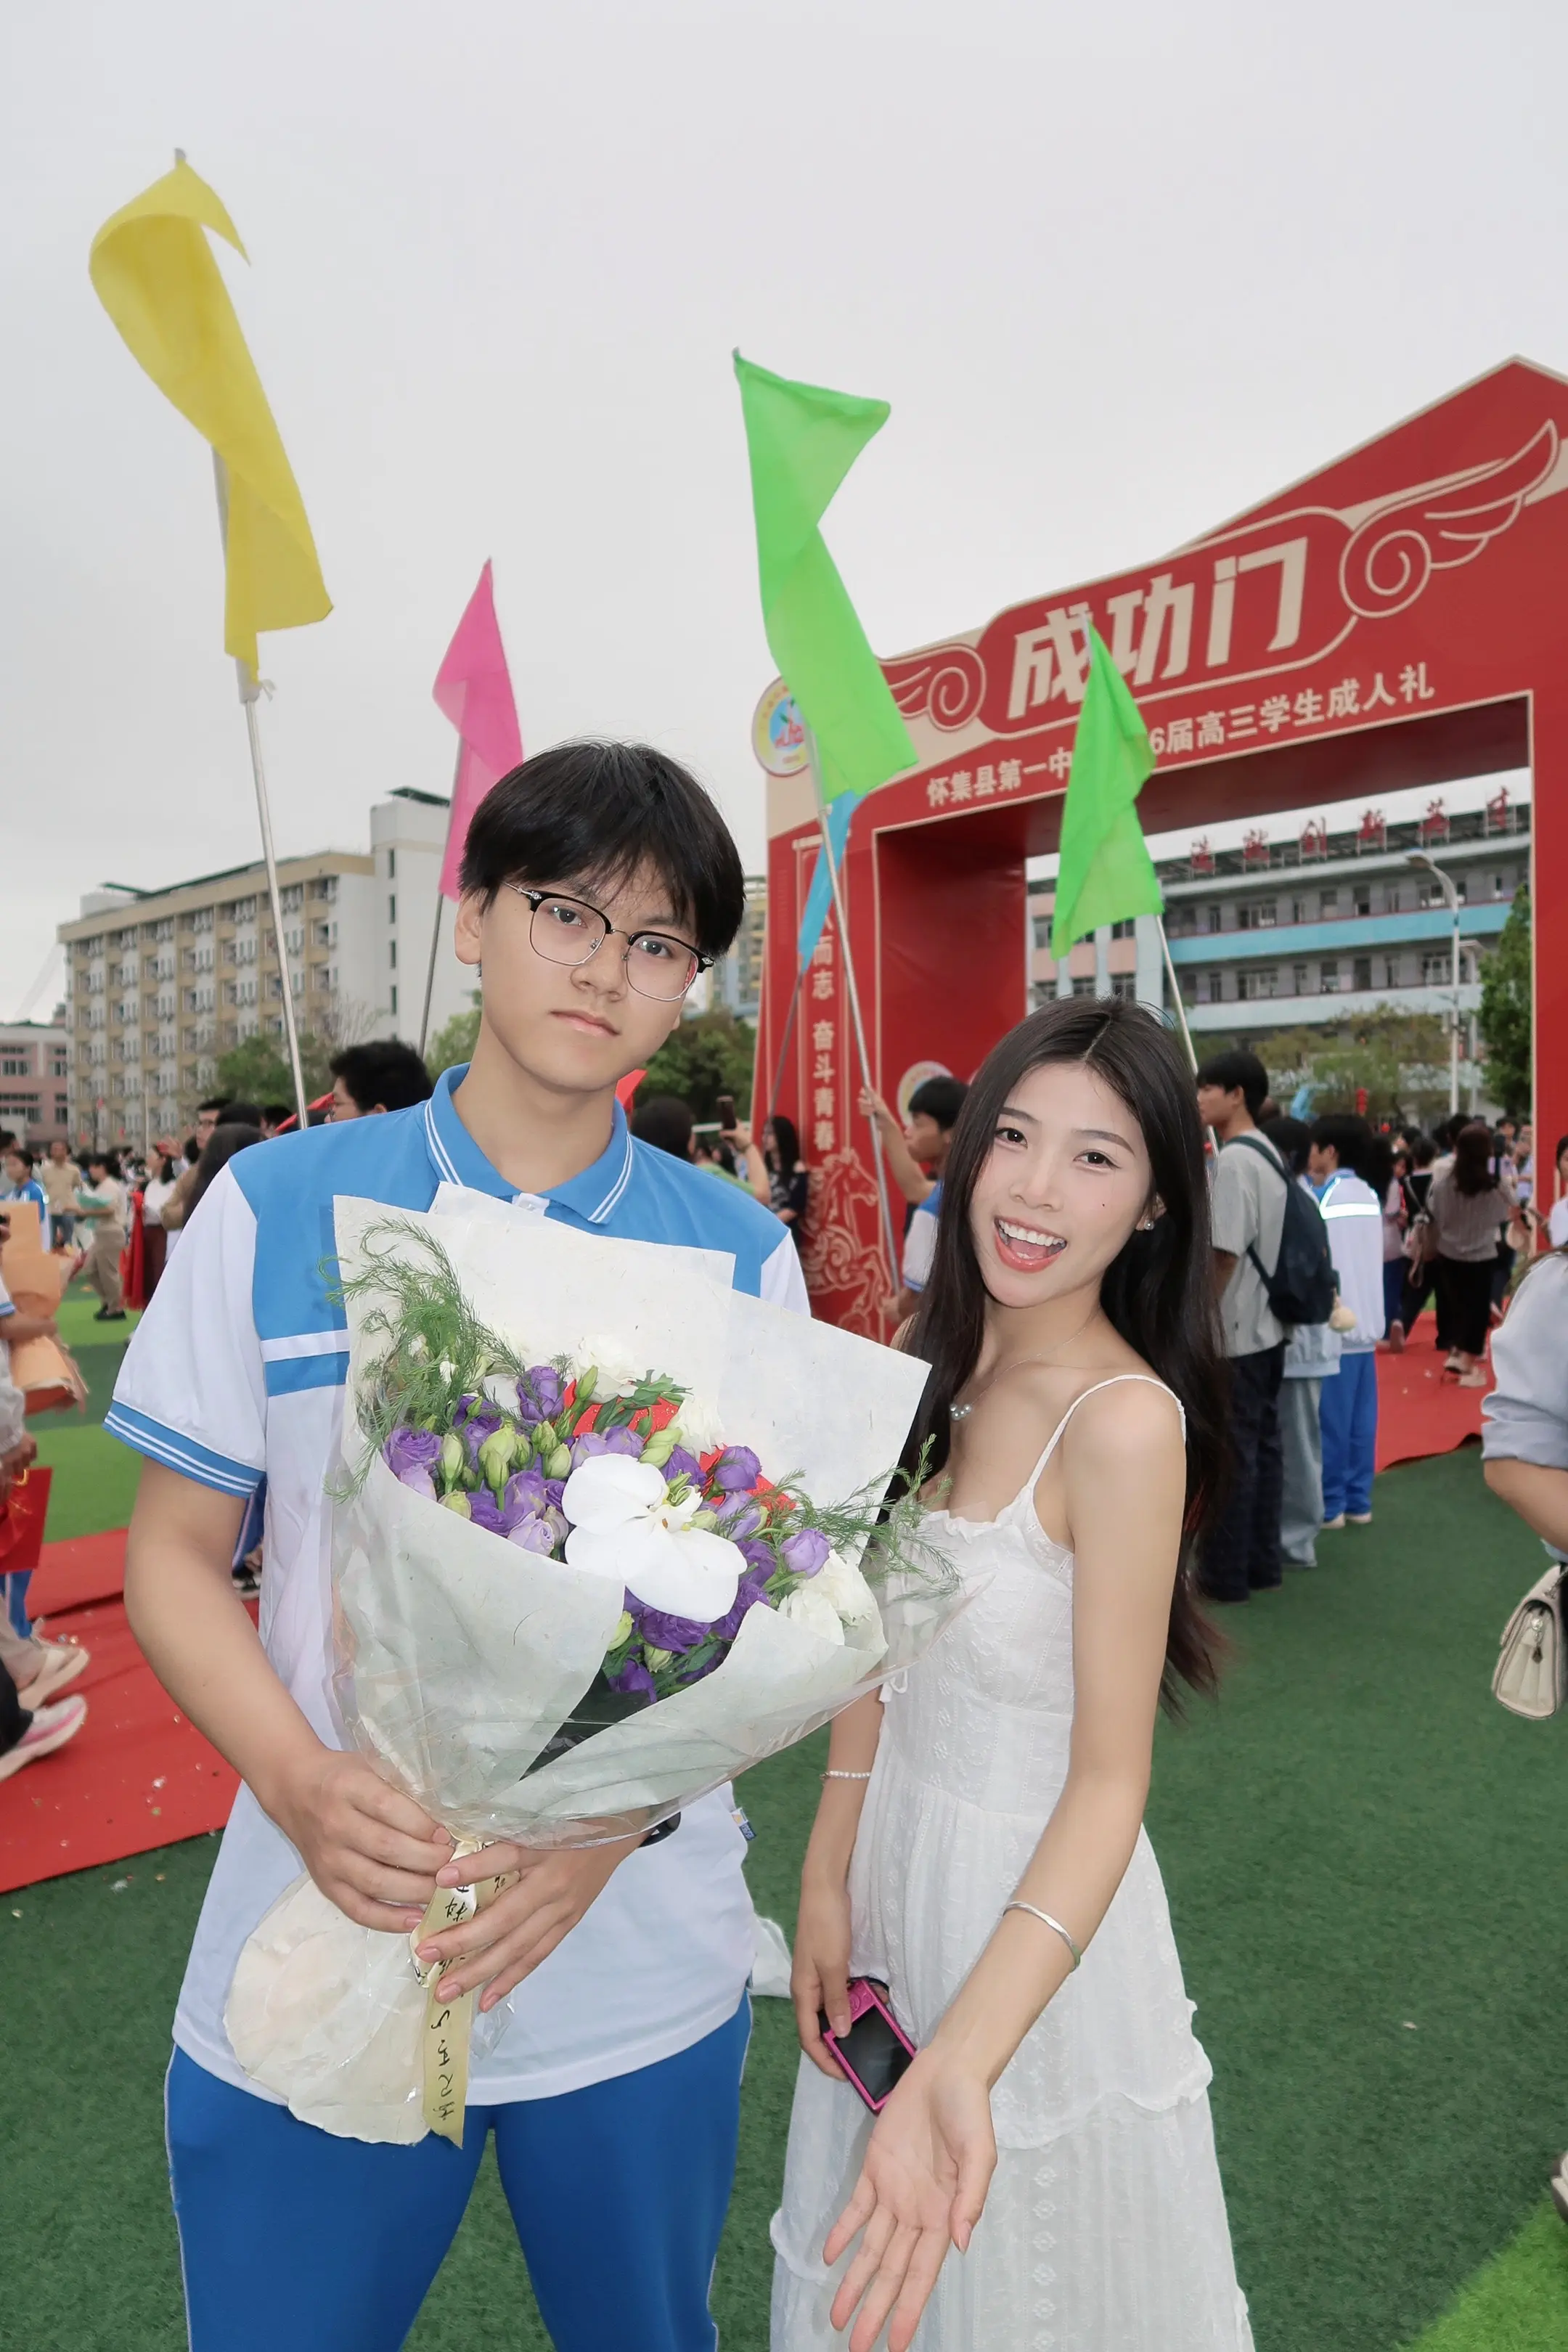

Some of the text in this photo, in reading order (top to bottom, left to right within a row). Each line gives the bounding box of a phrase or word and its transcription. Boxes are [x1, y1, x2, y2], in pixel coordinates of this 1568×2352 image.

[1008, 536, 1307, 720] 成功门
[811, 914, 835, 1000] 而志
[812, 1019, 836, 1151] 奋斗青春
